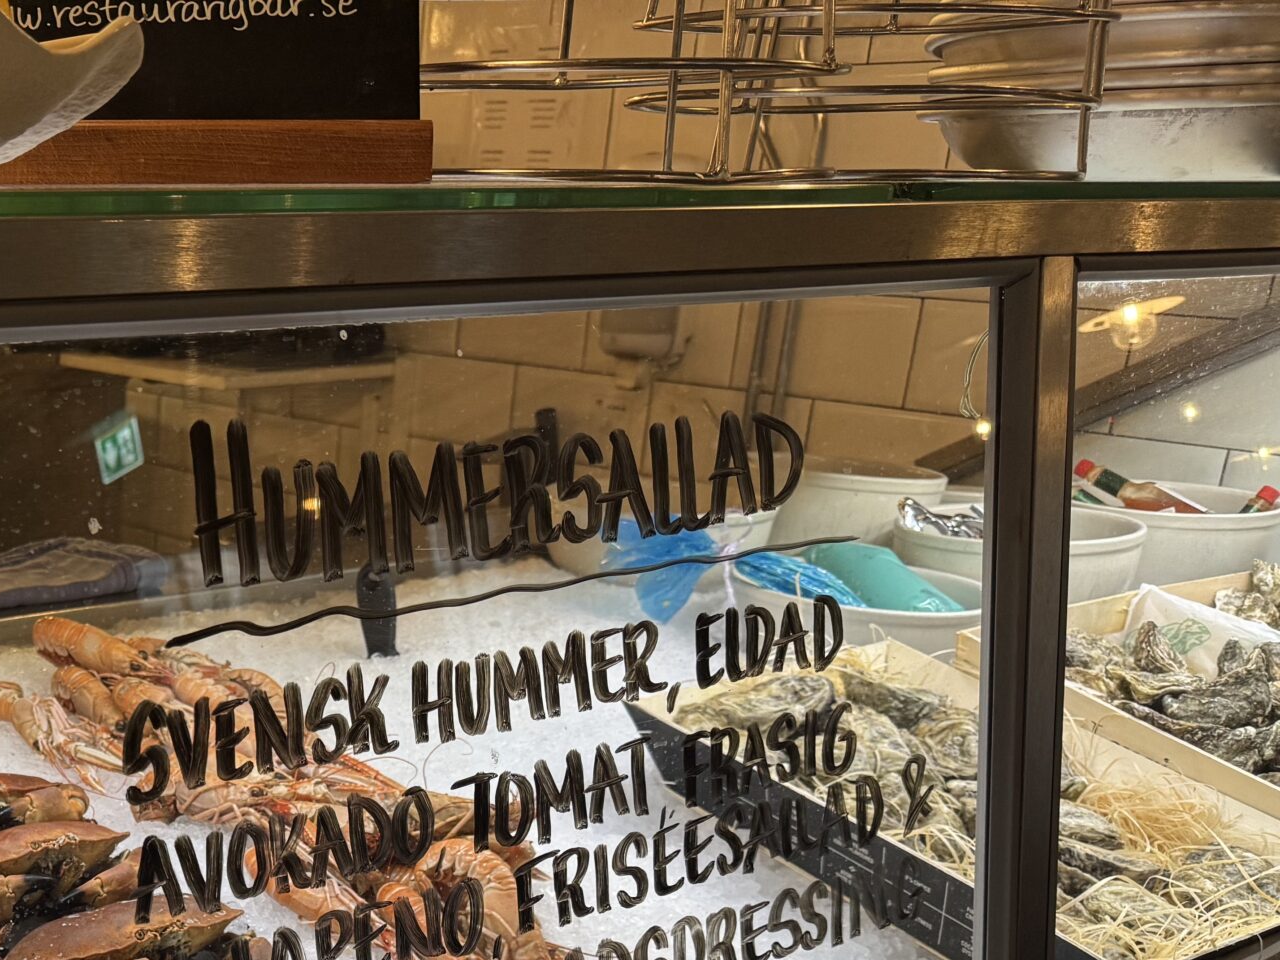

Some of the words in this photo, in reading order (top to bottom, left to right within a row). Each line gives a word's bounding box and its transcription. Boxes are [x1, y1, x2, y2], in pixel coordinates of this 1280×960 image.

[189, 410, 804, 587] HUMMERSALLAD
[124, 662, 400, 802] SVENSK
[411, 619, 681, 744] HUMMER,
[682, 702, 857, 808] FRASIG
[904, 754, 934, 838] &
